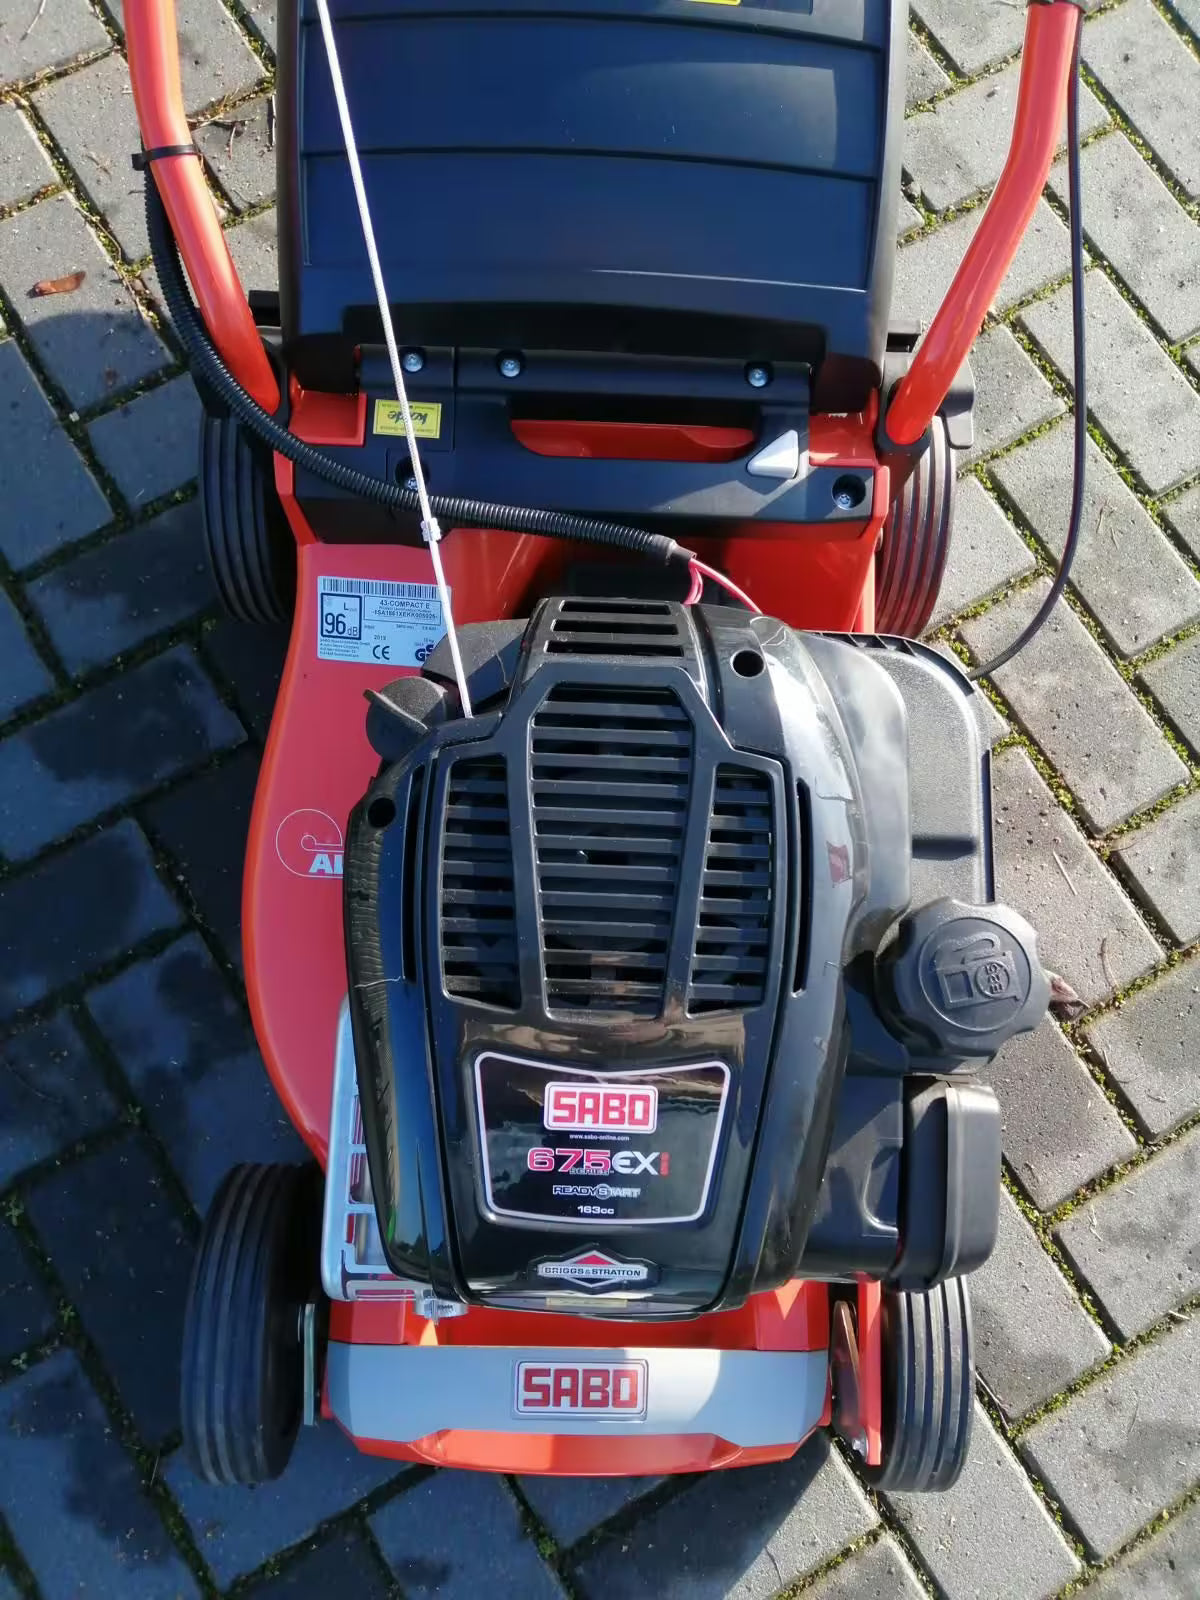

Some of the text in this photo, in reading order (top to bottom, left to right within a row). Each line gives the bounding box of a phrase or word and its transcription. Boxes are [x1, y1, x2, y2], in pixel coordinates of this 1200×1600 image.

[379, 600, 424, 609] 43-COMPACT
[325, 612, 358, 637] 96 dB
[372, 645, 390, 660] CE
[553, 1091, 651, 1126] SABO
[569, 1133, 630, 1141] www.sabo-online.com
[577, 1205, 615, 1215] 163cc
[523, 1368, 639, 1408] SABO
